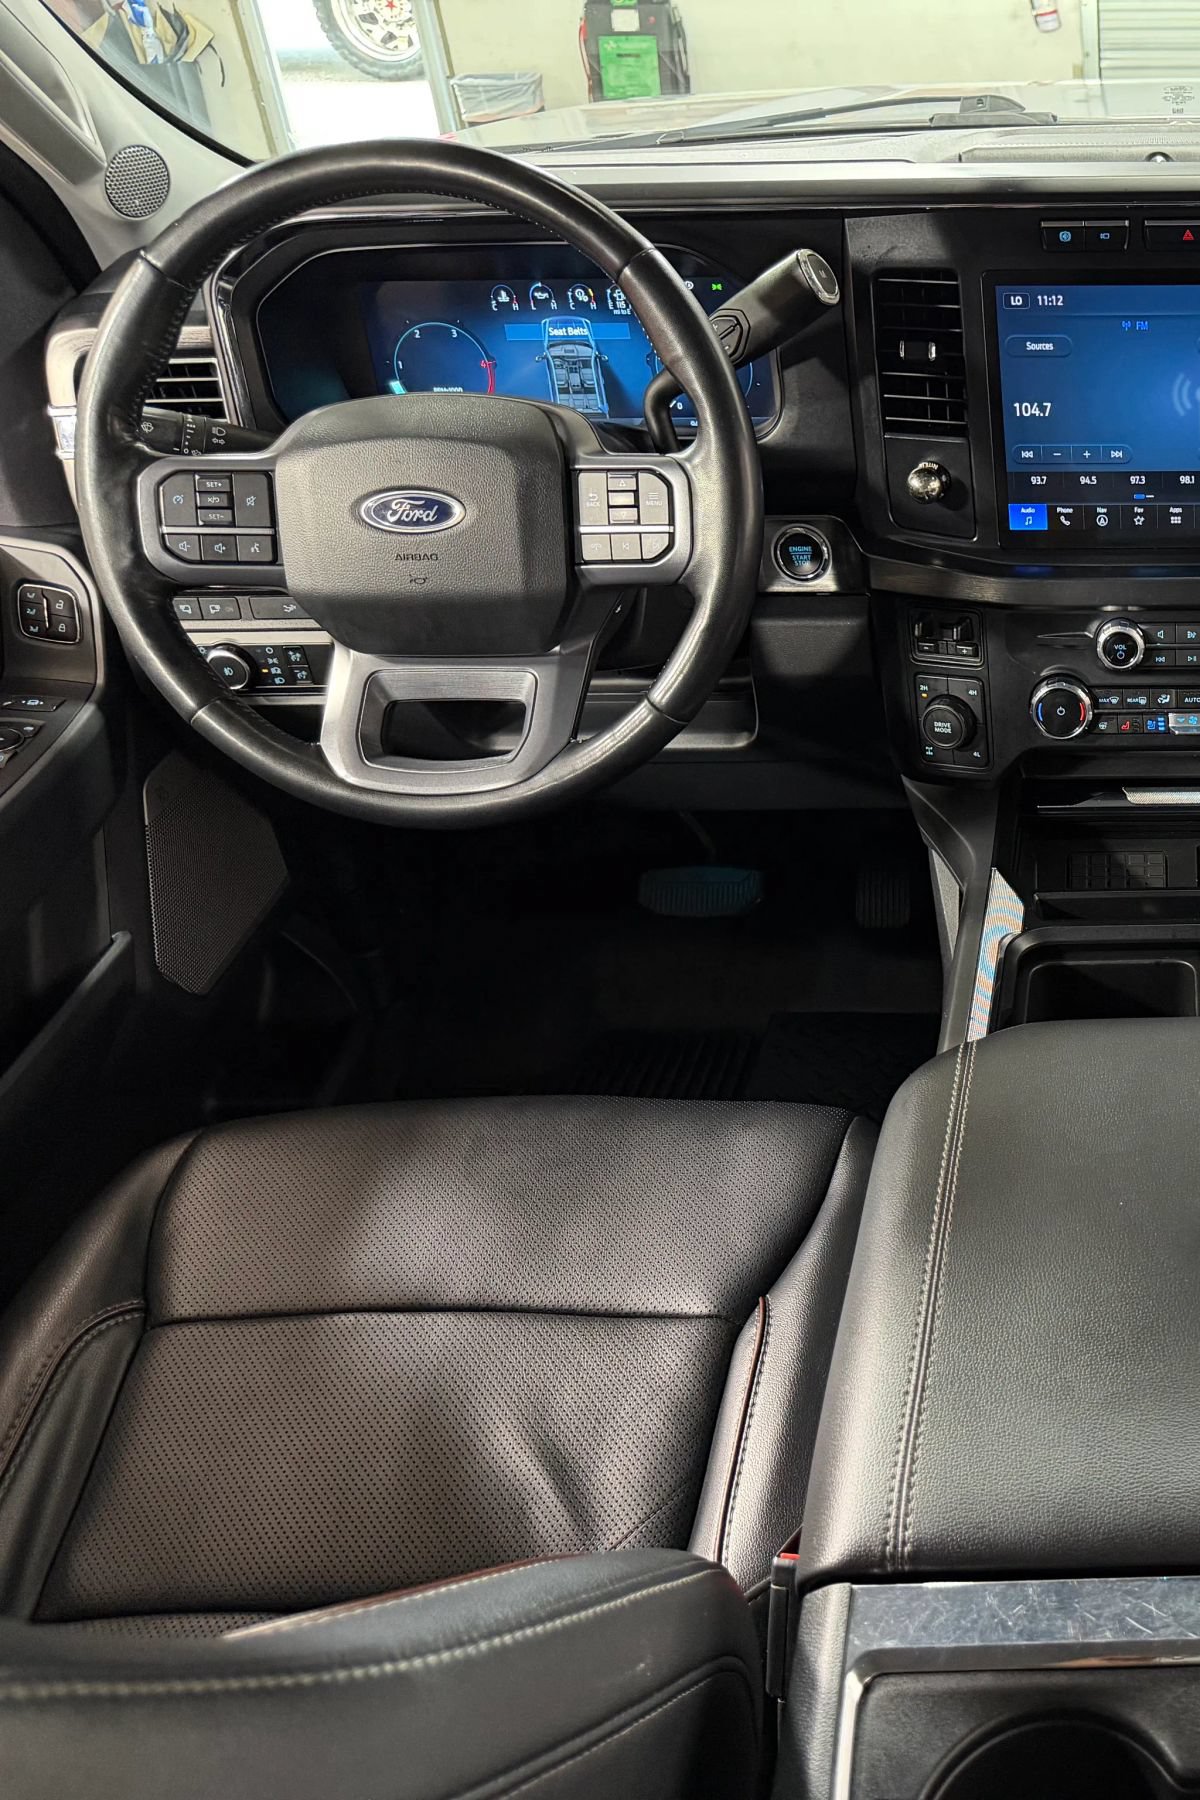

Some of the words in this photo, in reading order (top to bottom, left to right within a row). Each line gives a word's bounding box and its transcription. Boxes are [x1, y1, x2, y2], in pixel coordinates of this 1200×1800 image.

[1010, 295, 1022, 306] LO
[1037, 295, 1064, 306] 11:12
[512, 303, 520, 311] H
[1136, 322, 1148, 330] FM
[414, 329, 421, 338] 2
[451, 329, 458, 338] 3
[549, 327, 567, 336] Seat
[568, 327, 588, 336] Belts
[1026, 341, 1054, 351] Sources
[1013, 402, 1052, 417] 104.7
[1030, 476, 1047, 485] 93.7
[1079, 475, 1097, 485] 94.5
[1129, 475, 1146, 485] 97.3
[1179, 475, 1195, 485] 98.1
[386, 499, 439, 522] Ford
[1020, 506, 1036, 514] Audio
[1056, 506, 1074, 514] Phone
[1096, 506, 1108, 514] Nav
[1169, 506, 1183, 514] Apps
[395, 553, 441, 561] AIRBAG
